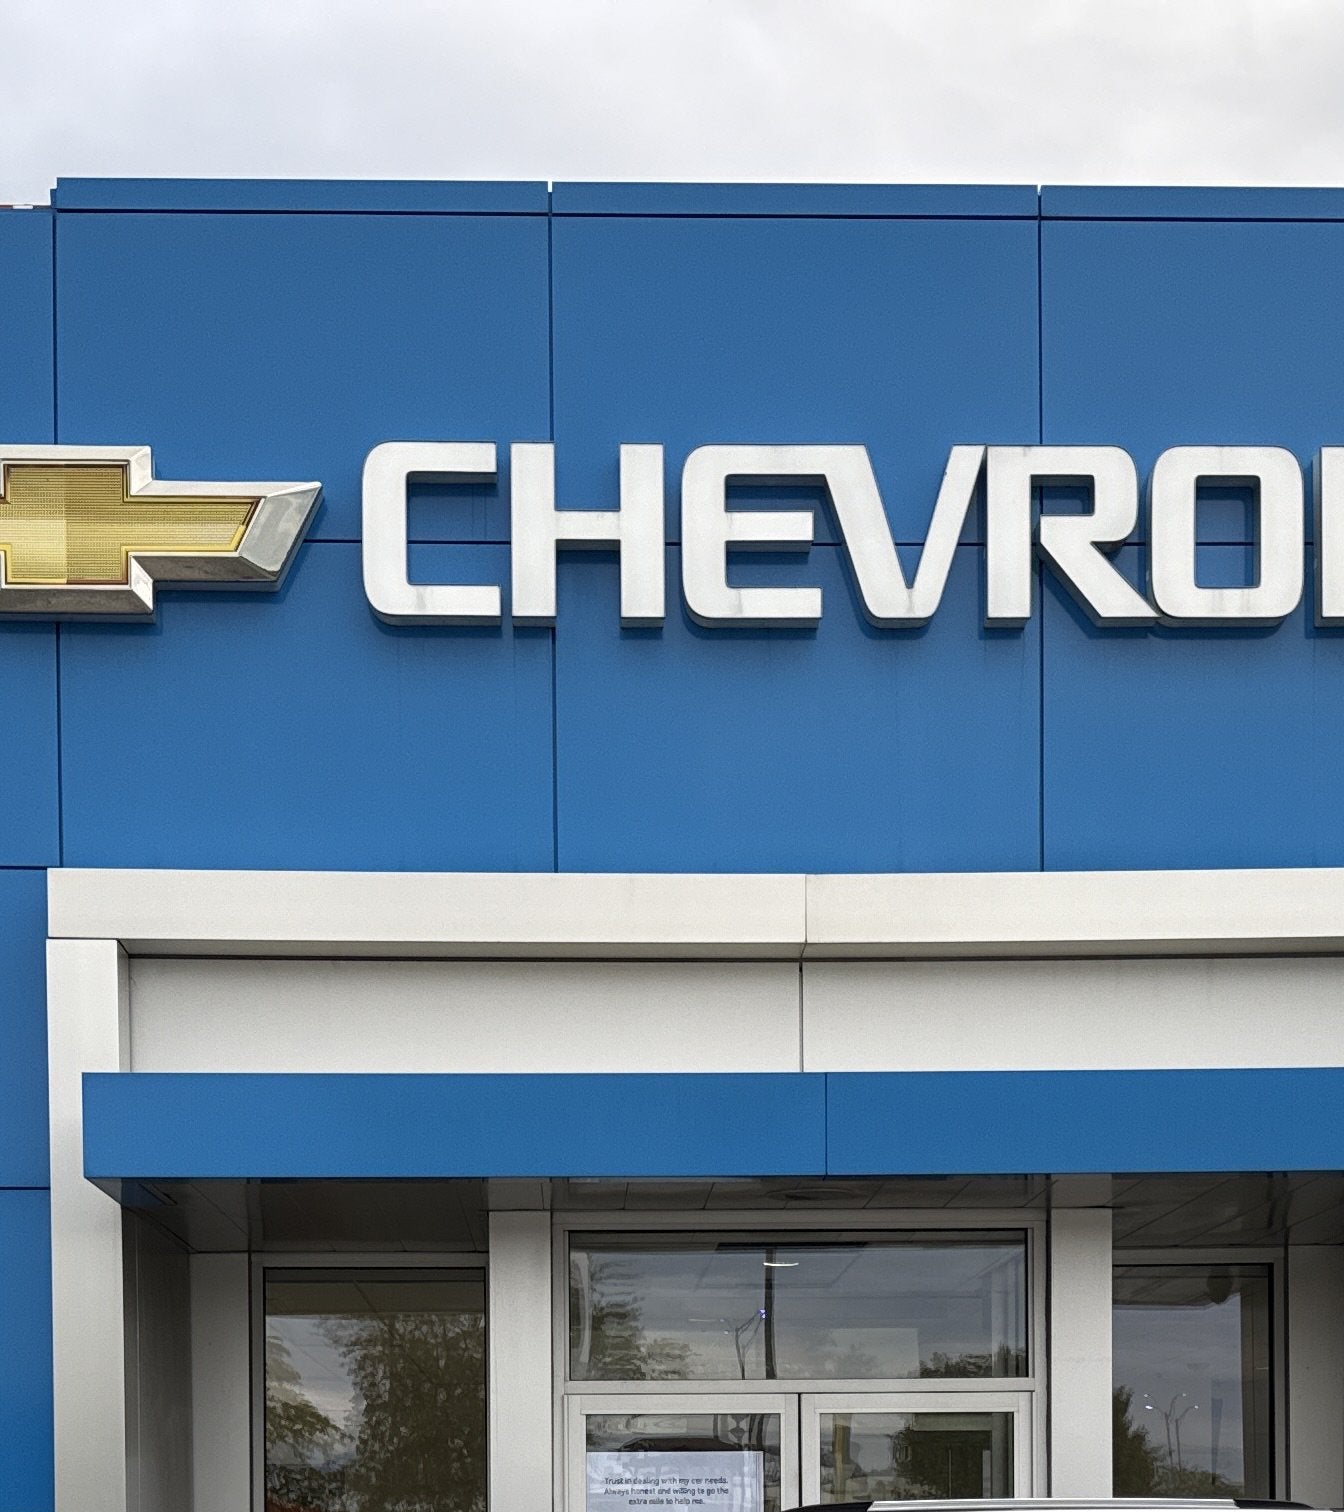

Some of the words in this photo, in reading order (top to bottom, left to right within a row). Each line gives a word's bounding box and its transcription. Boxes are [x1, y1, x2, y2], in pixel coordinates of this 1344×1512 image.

[604, 1477, 623, 1485] Trust
[661, 1477, 677, 1485] with
[604, 1488, 630, 1496] Always
[631, 1487, 656, 1495] honest
[657, 1487, 671, 1495] and
